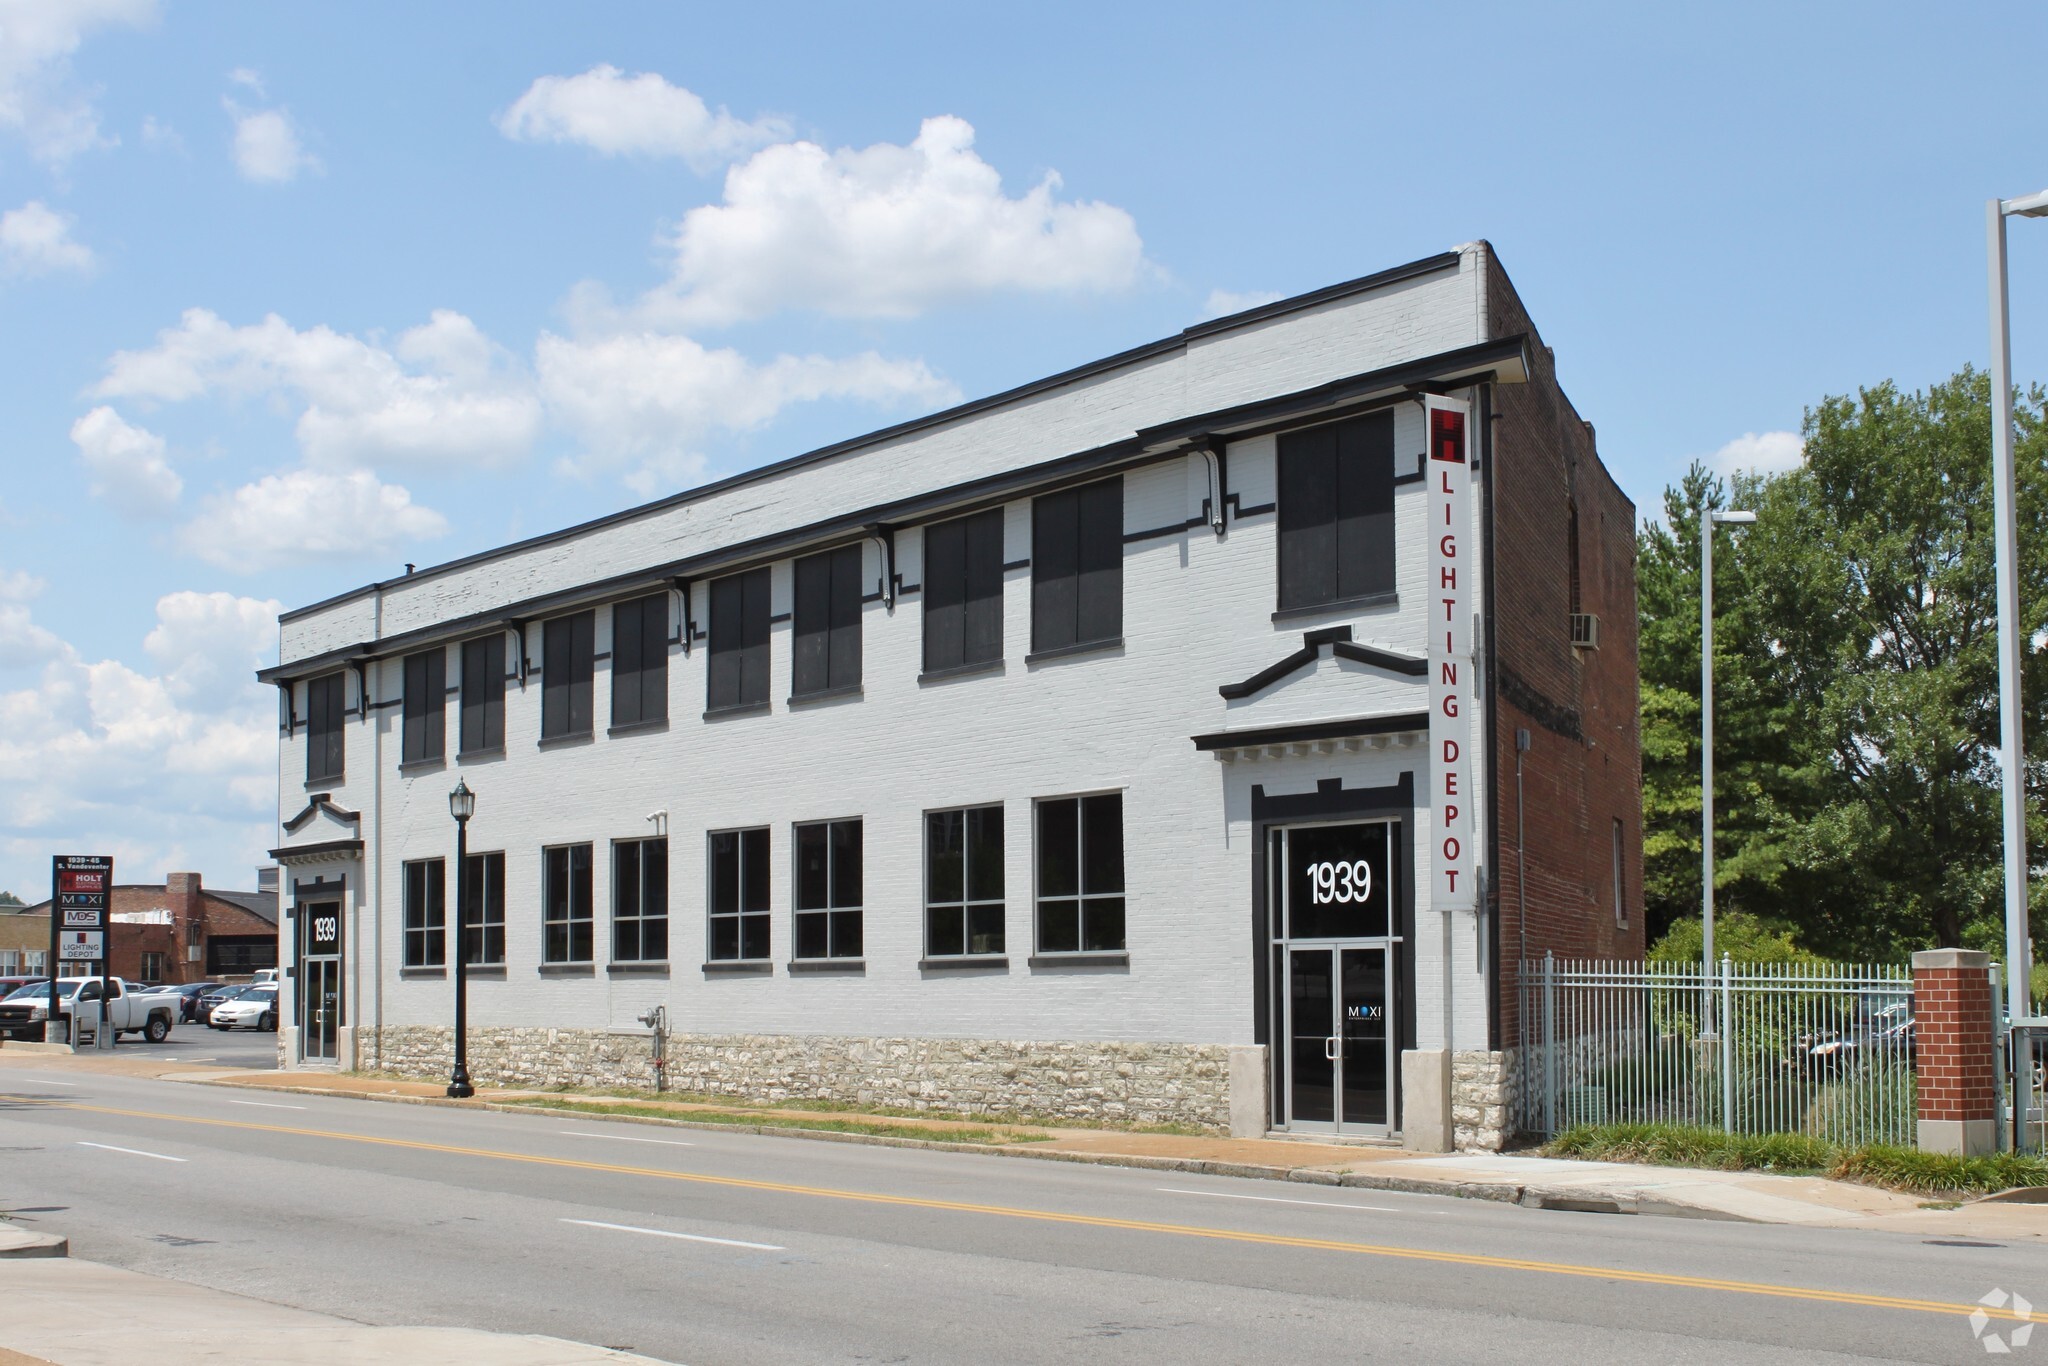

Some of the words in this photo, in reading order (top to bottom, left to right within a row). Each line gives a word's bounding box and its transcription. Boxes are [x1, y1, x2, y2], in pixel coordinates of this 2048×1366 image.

[1440, 471, 1458, 717] LIGHTING
[1443, 740, 1460, 893] DEPOT
[1307, 860, 1371, 904] 1939
[62, 895, 102, 903] MOXI
[68, 912, 96, 921] MDS
[315, 917, 336, 941] 1939
[1348, 1006, 1381, 1017] MOXI
